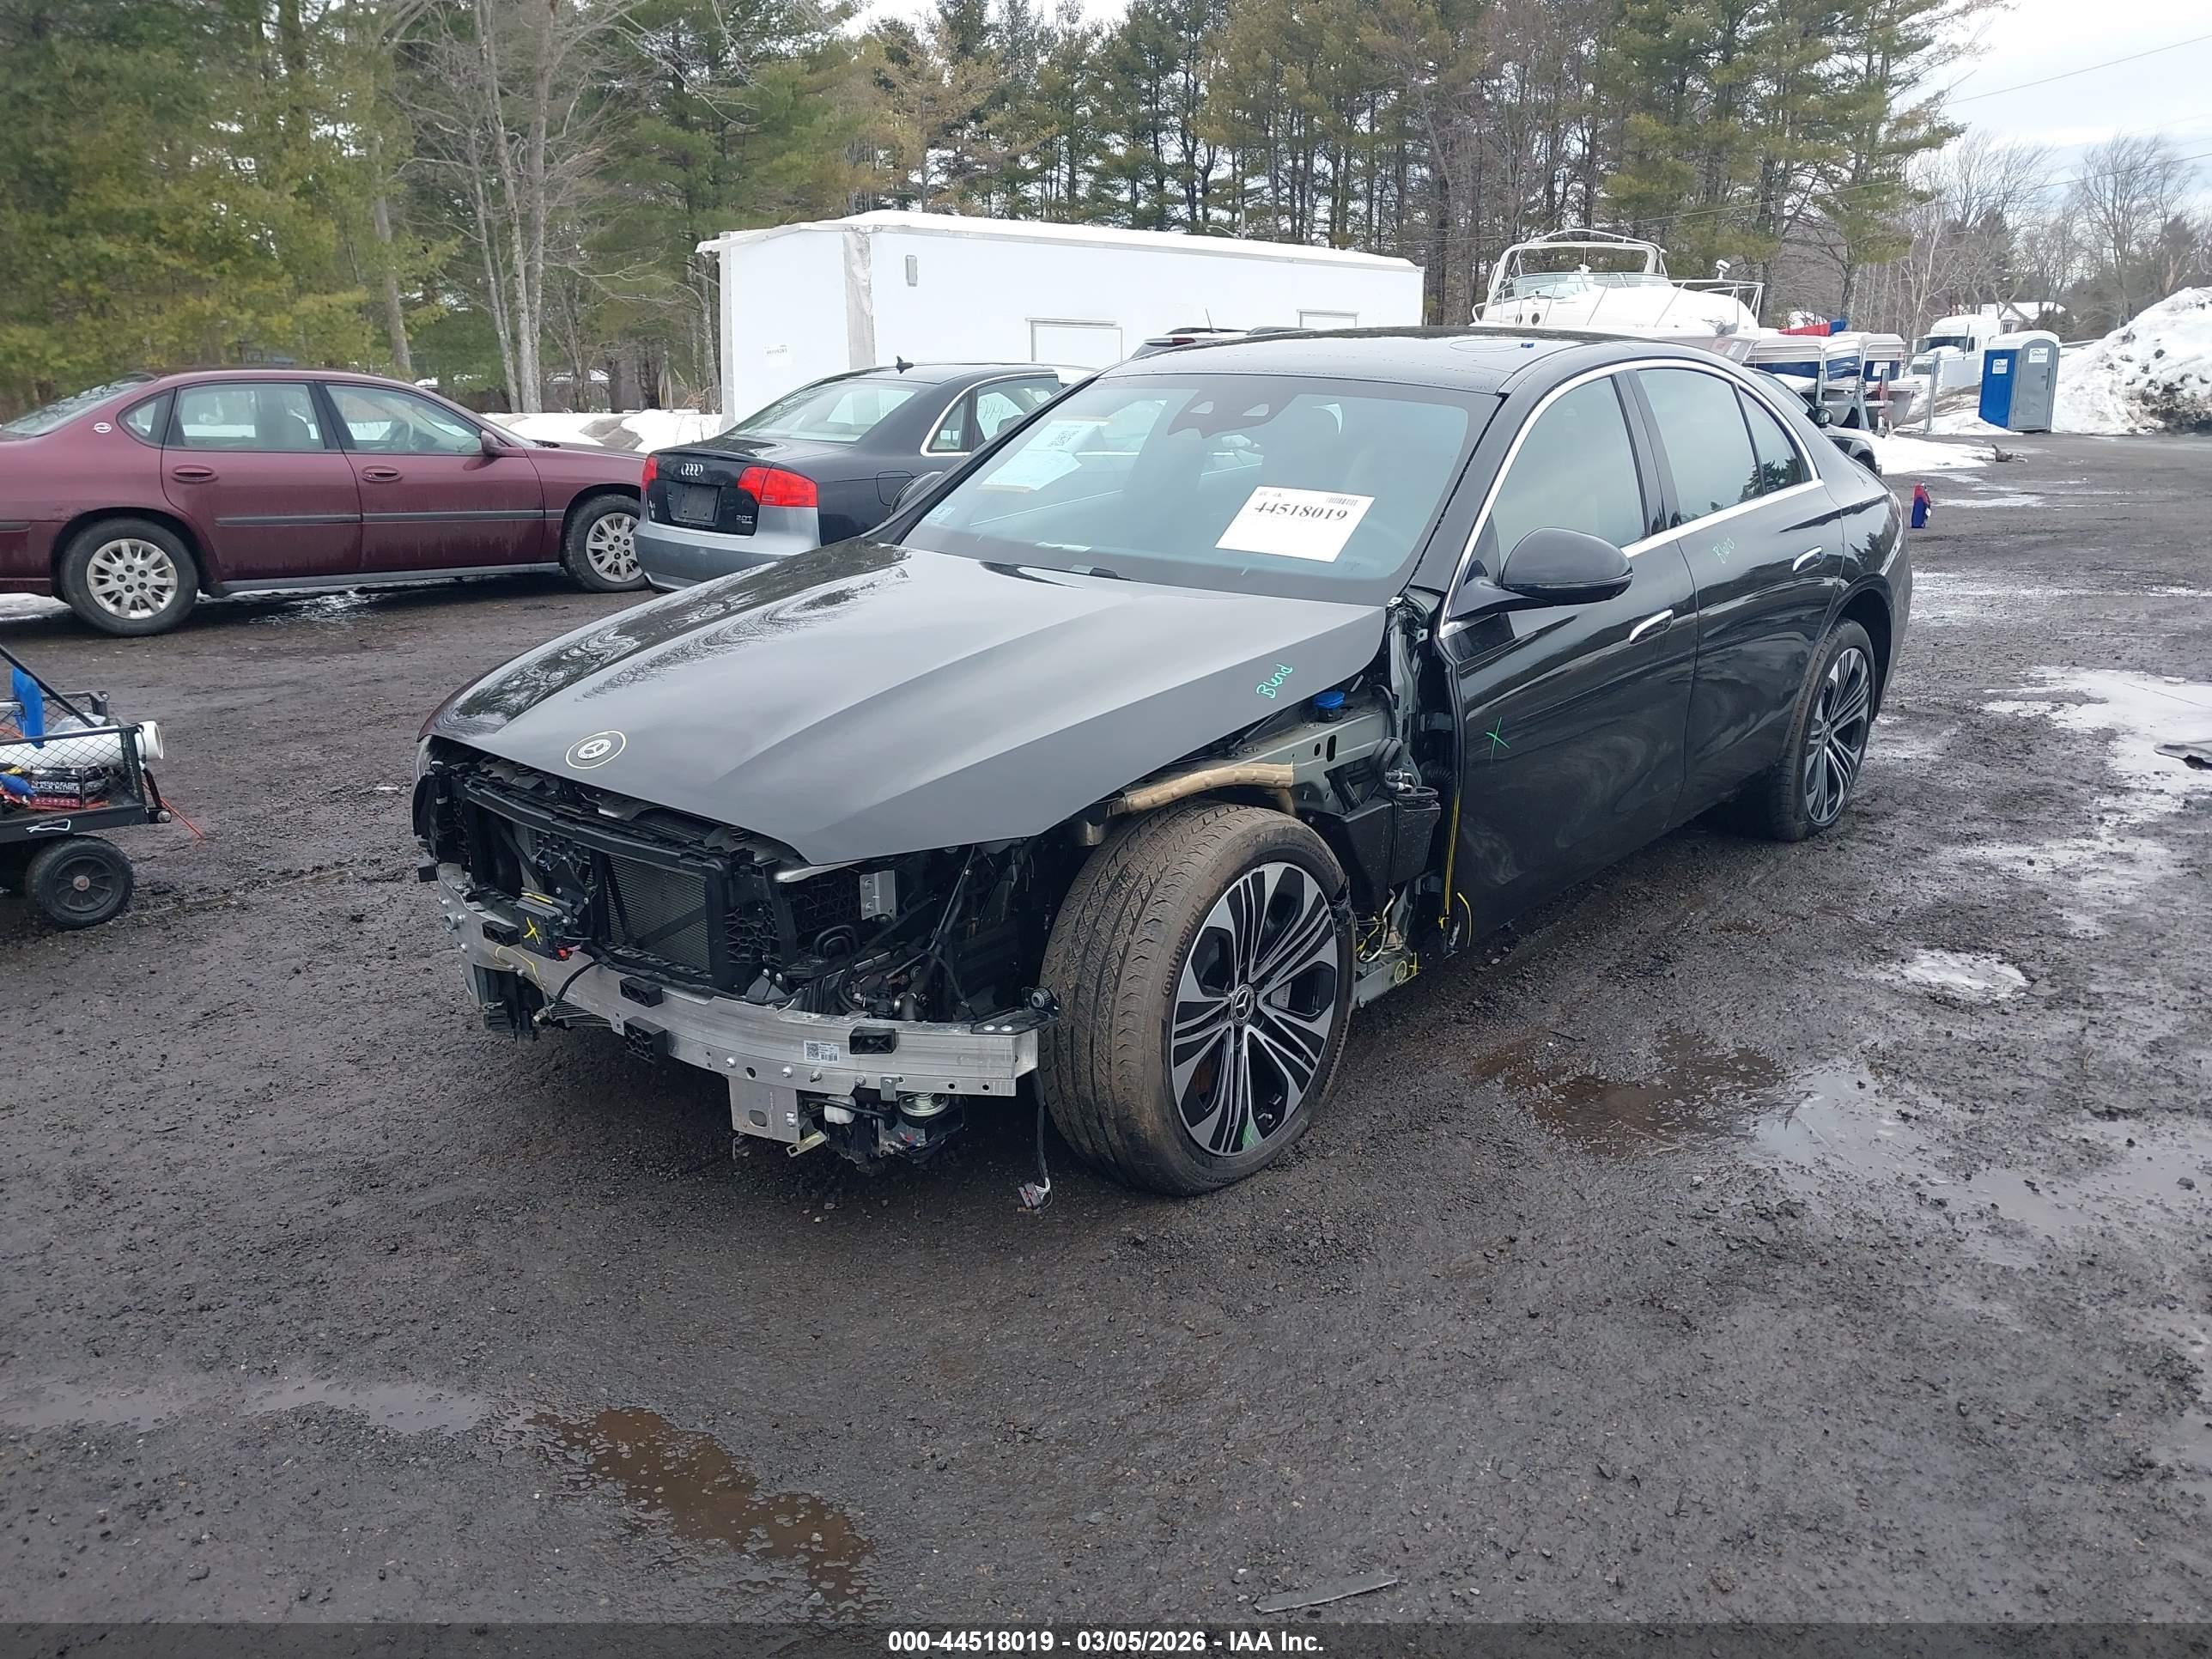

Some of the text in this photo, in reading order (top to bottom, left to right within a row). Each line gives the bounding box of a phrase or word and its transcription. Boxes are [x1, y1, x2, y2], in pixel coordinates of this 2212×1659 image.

[1255, 501, 1348, 521] 44518019
[1256, 663, 1293, 699] Blend
[1161, 903, 1203, 997] Continental
